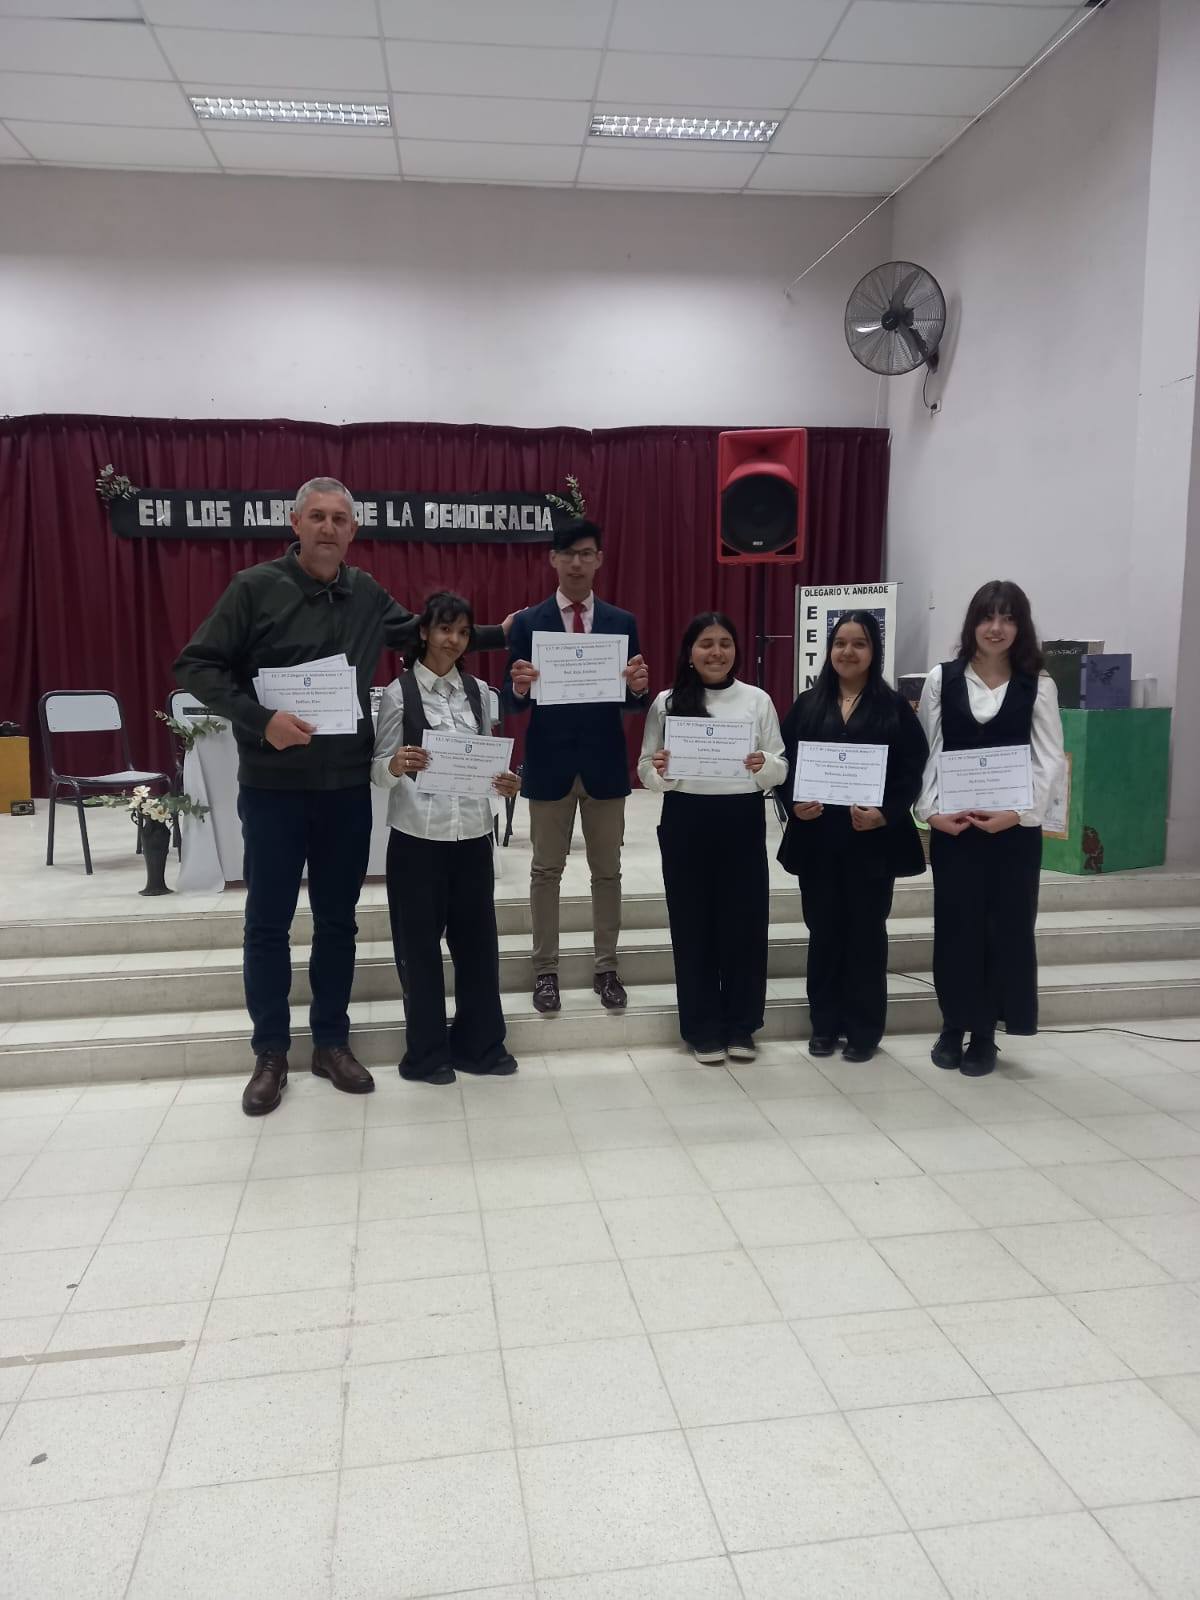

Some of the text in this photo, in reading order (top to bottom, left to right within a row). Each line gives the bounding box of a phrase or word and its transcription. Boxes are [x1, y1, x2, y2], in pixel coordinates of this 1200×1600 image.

[139, 499, 171, 526] EN
[186, 500, 231, 527] LOS
[353, 501, 378, 527] DE
[386, 501, 414, 527] LA
[424, 502, 553, 531] DEMOCRACIA
[804, 585, 889, 597] OLEGARIO V. ANDRADE
